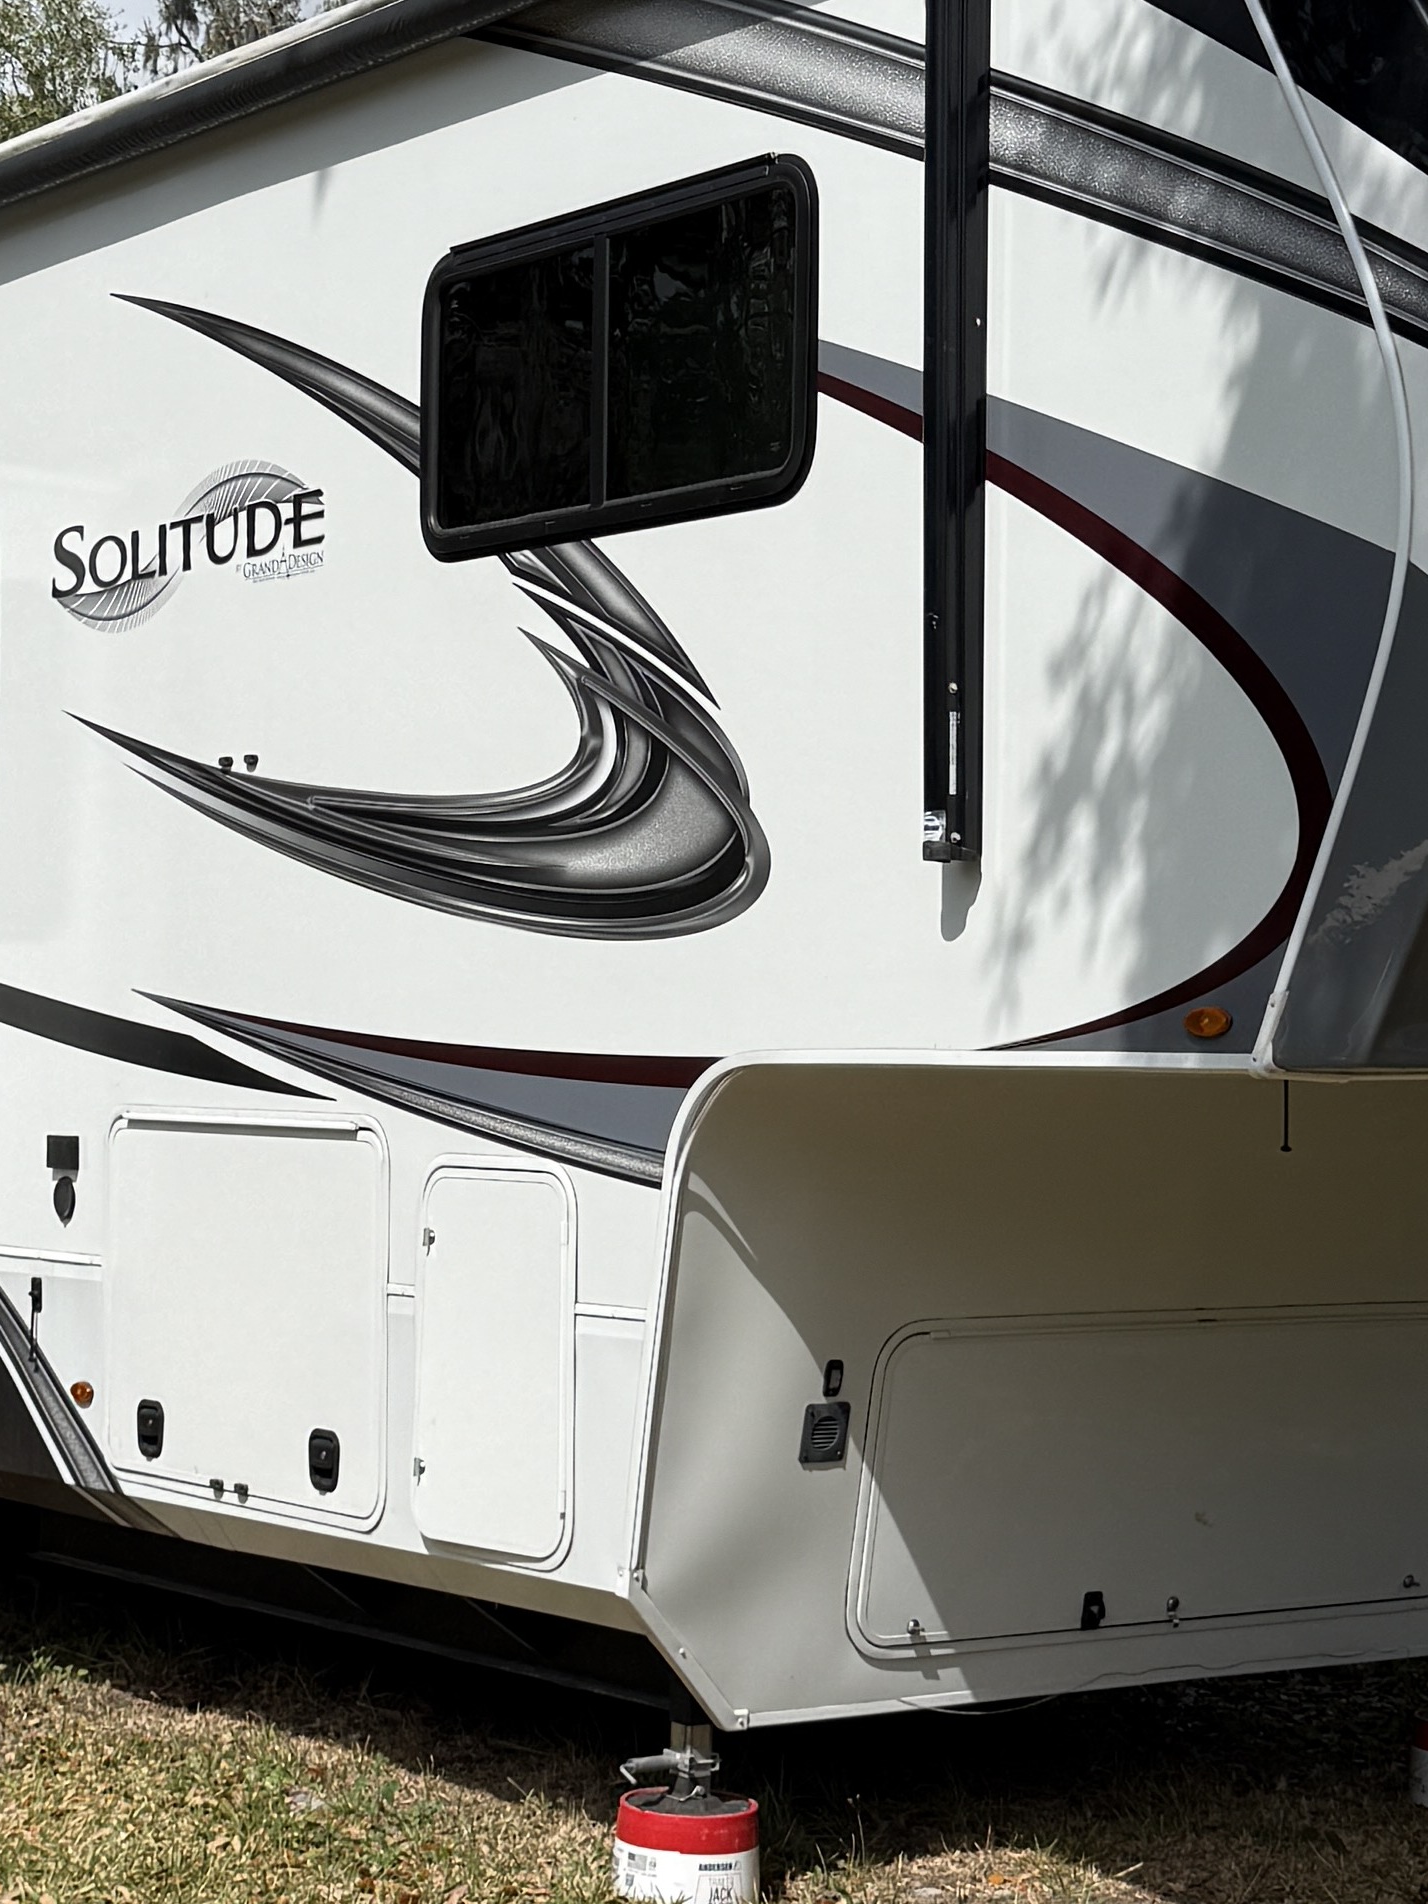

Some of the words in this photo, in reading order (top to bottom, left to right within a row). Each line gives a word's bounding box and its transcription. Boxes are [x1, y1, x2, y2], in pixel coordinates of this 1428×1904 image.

[51, 488, 326, 599] SOLITUDE
[243, 559, 280, 579] GRAND
[288, 550, 324, 569] DESIGN
[709, 1887, 734, 1902] JACK
